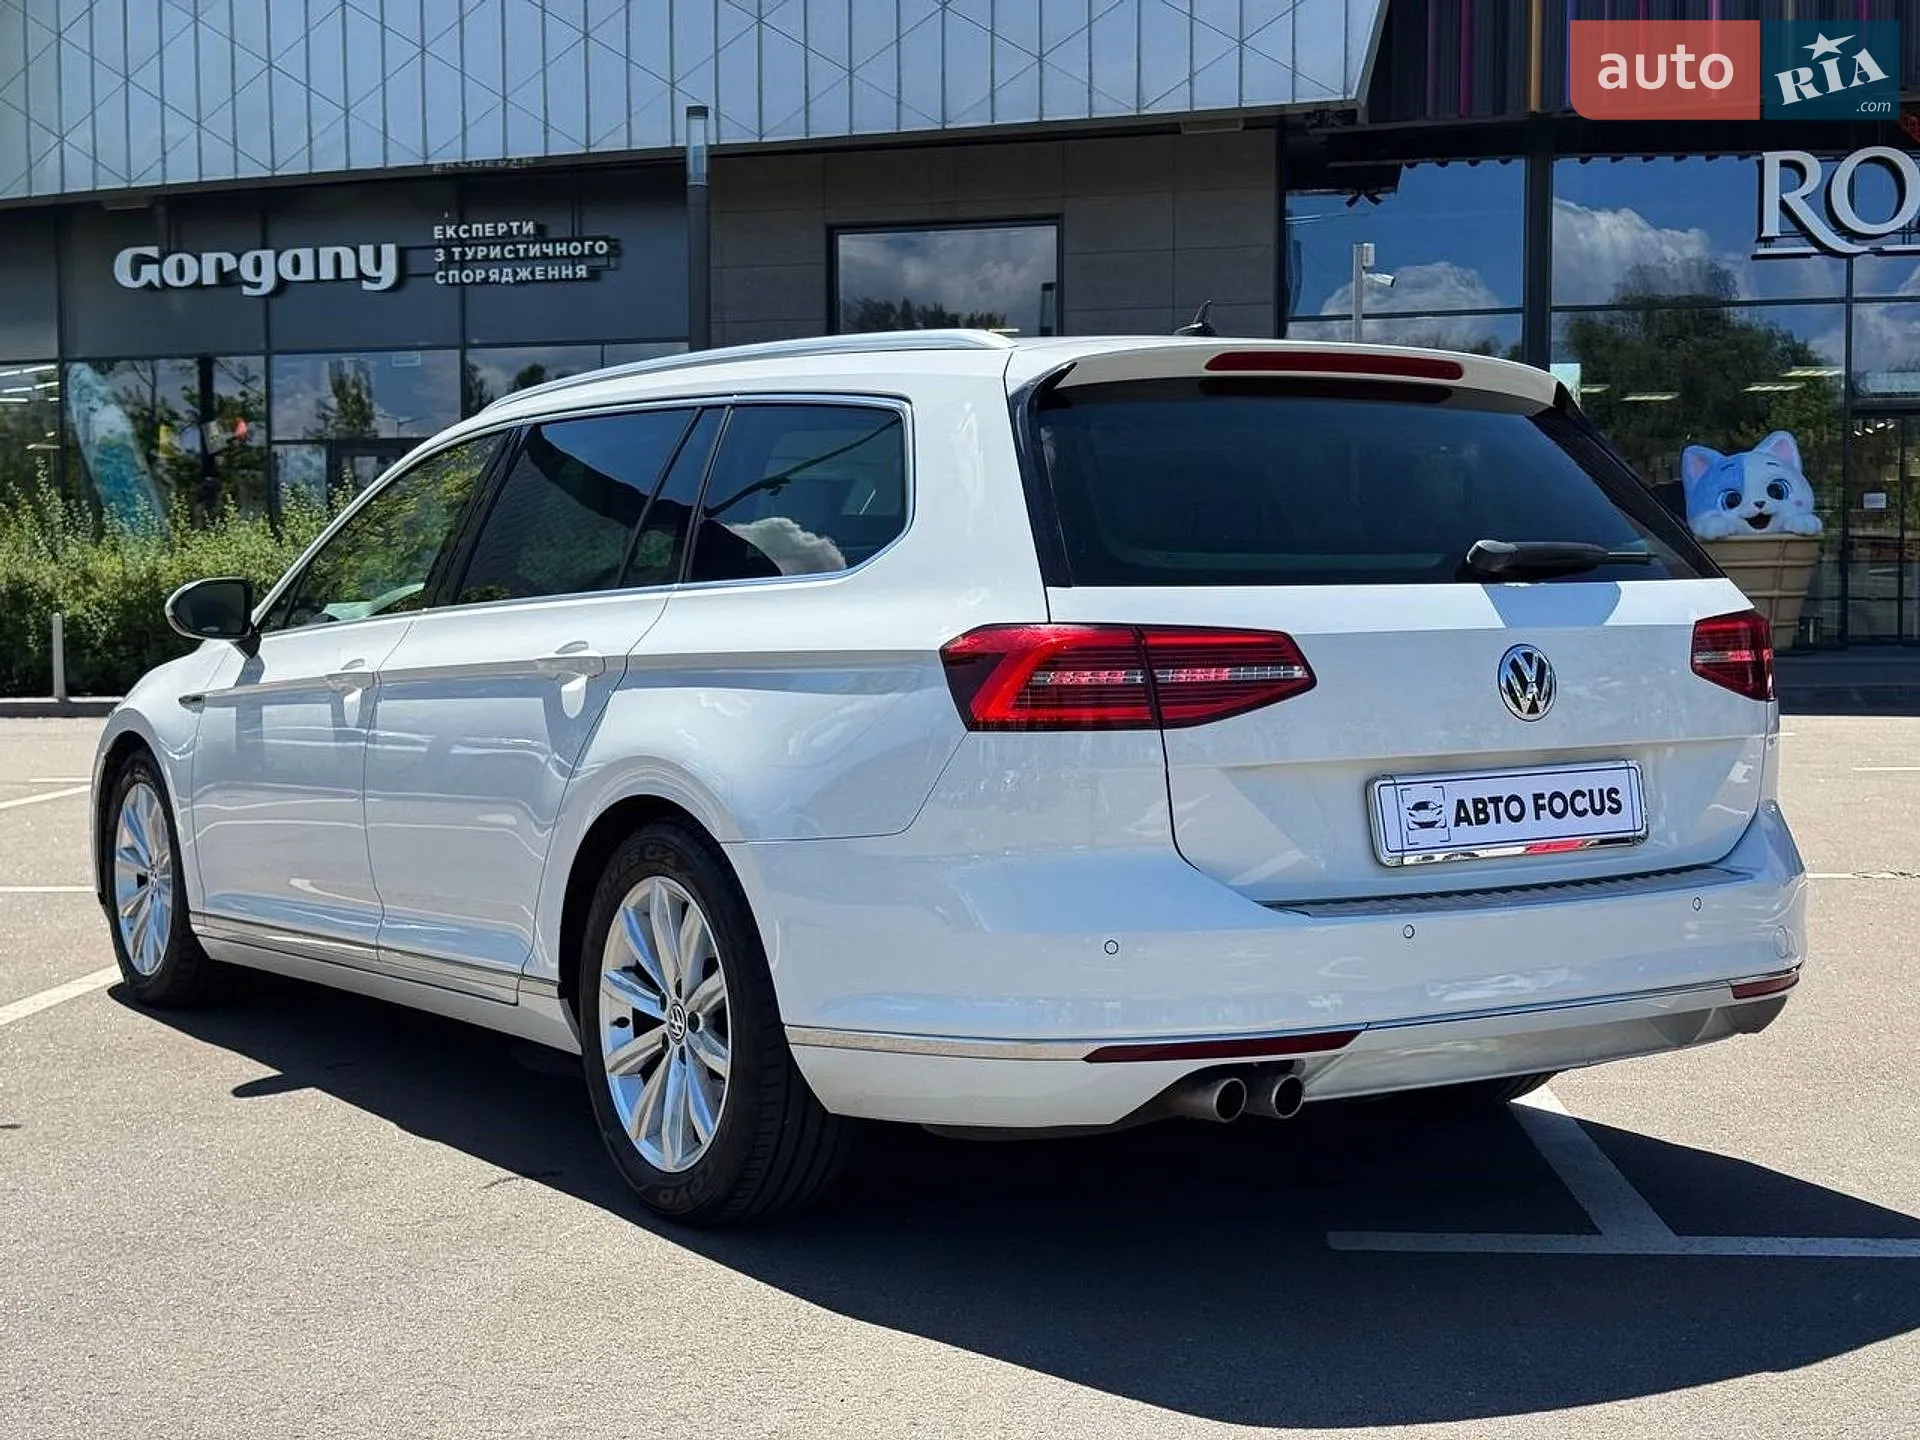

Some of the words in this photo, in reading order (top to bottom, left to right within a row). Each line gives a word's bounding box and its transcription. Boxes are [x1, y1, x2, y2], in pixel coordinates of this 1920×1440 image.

[433, 220, 536, 240] ЕКСПЕРТИ
[451, 241, 609, 261] ТУРИСТИЧНОГО
[113, 243, 397, 297] Gorgany
[434, 265, 589, 284] СПОРЯДЖЕННЯ
[1533, 787, 1623, 821] FOCUS
